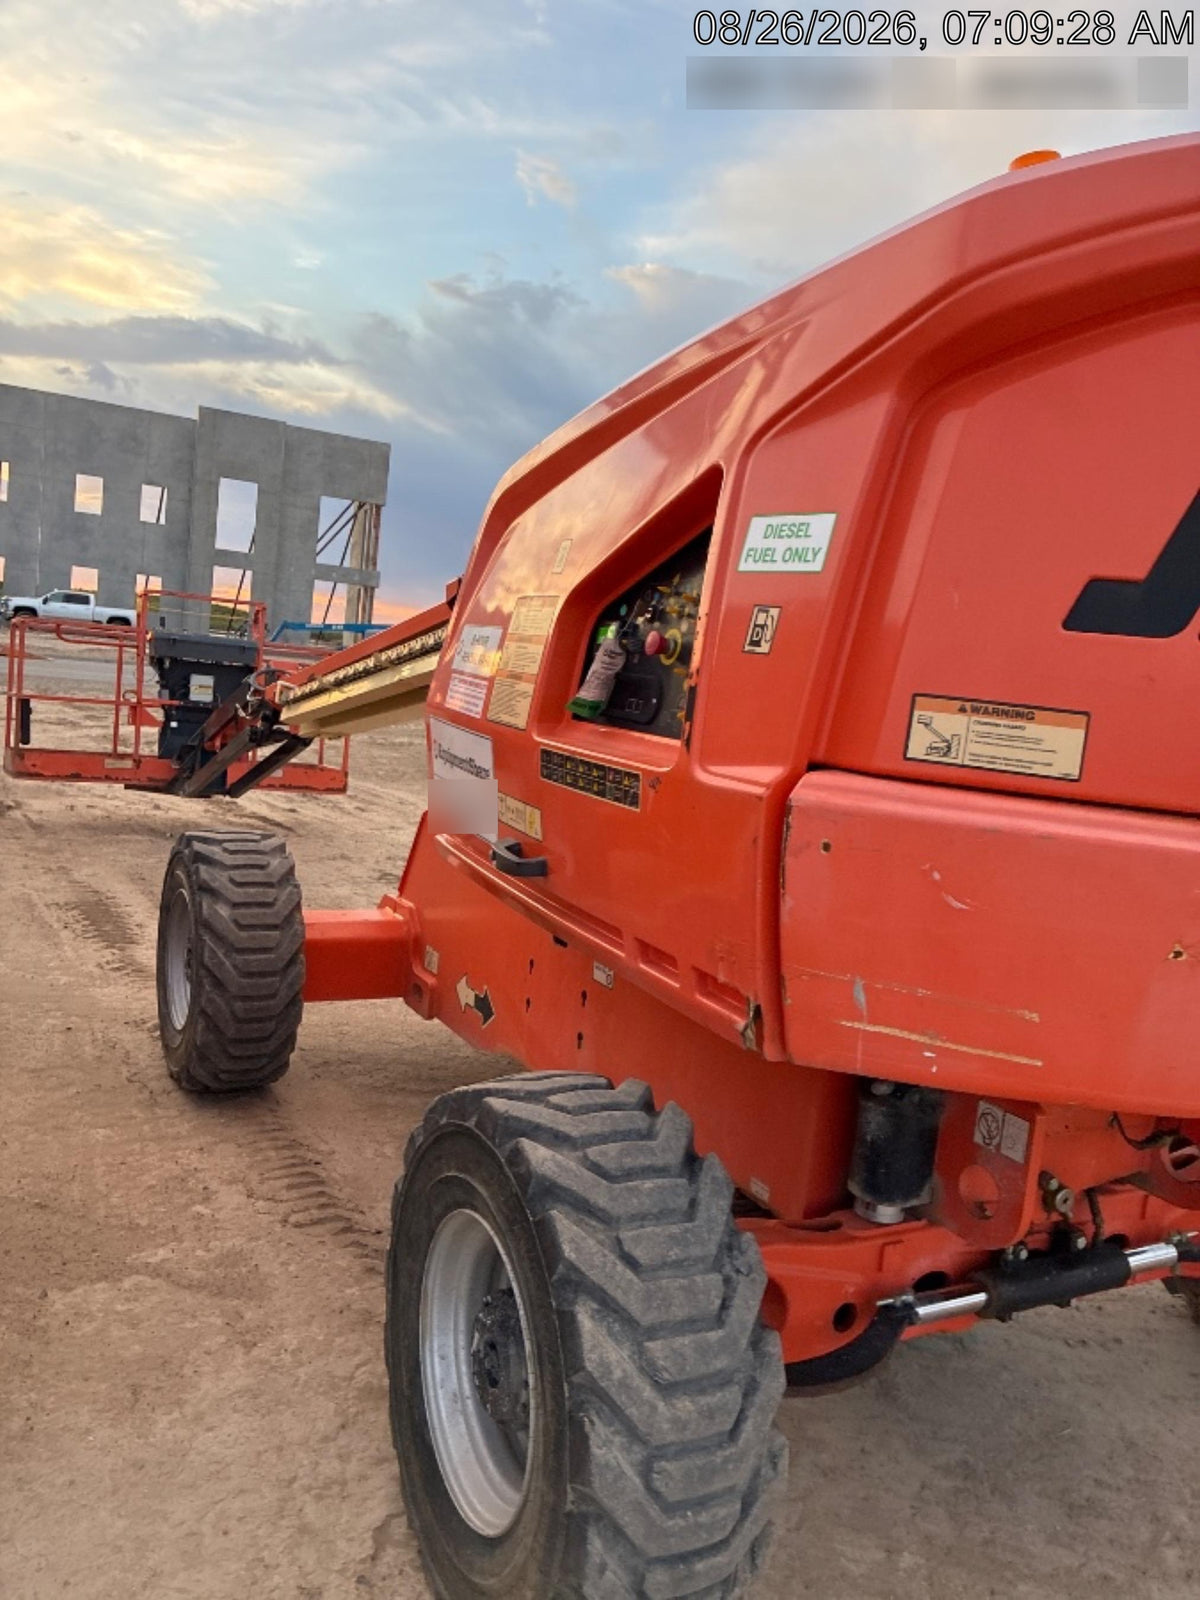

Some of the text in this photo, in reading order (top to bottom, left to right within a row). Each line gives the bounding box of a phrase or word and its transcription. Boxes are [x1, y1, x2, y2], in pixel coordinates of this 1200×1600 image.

[764, 523, 812, 539] DIESEL
[744, 547, 821, 564] FUEL ONLY
[970, 703, 1036, 721] WARNING
